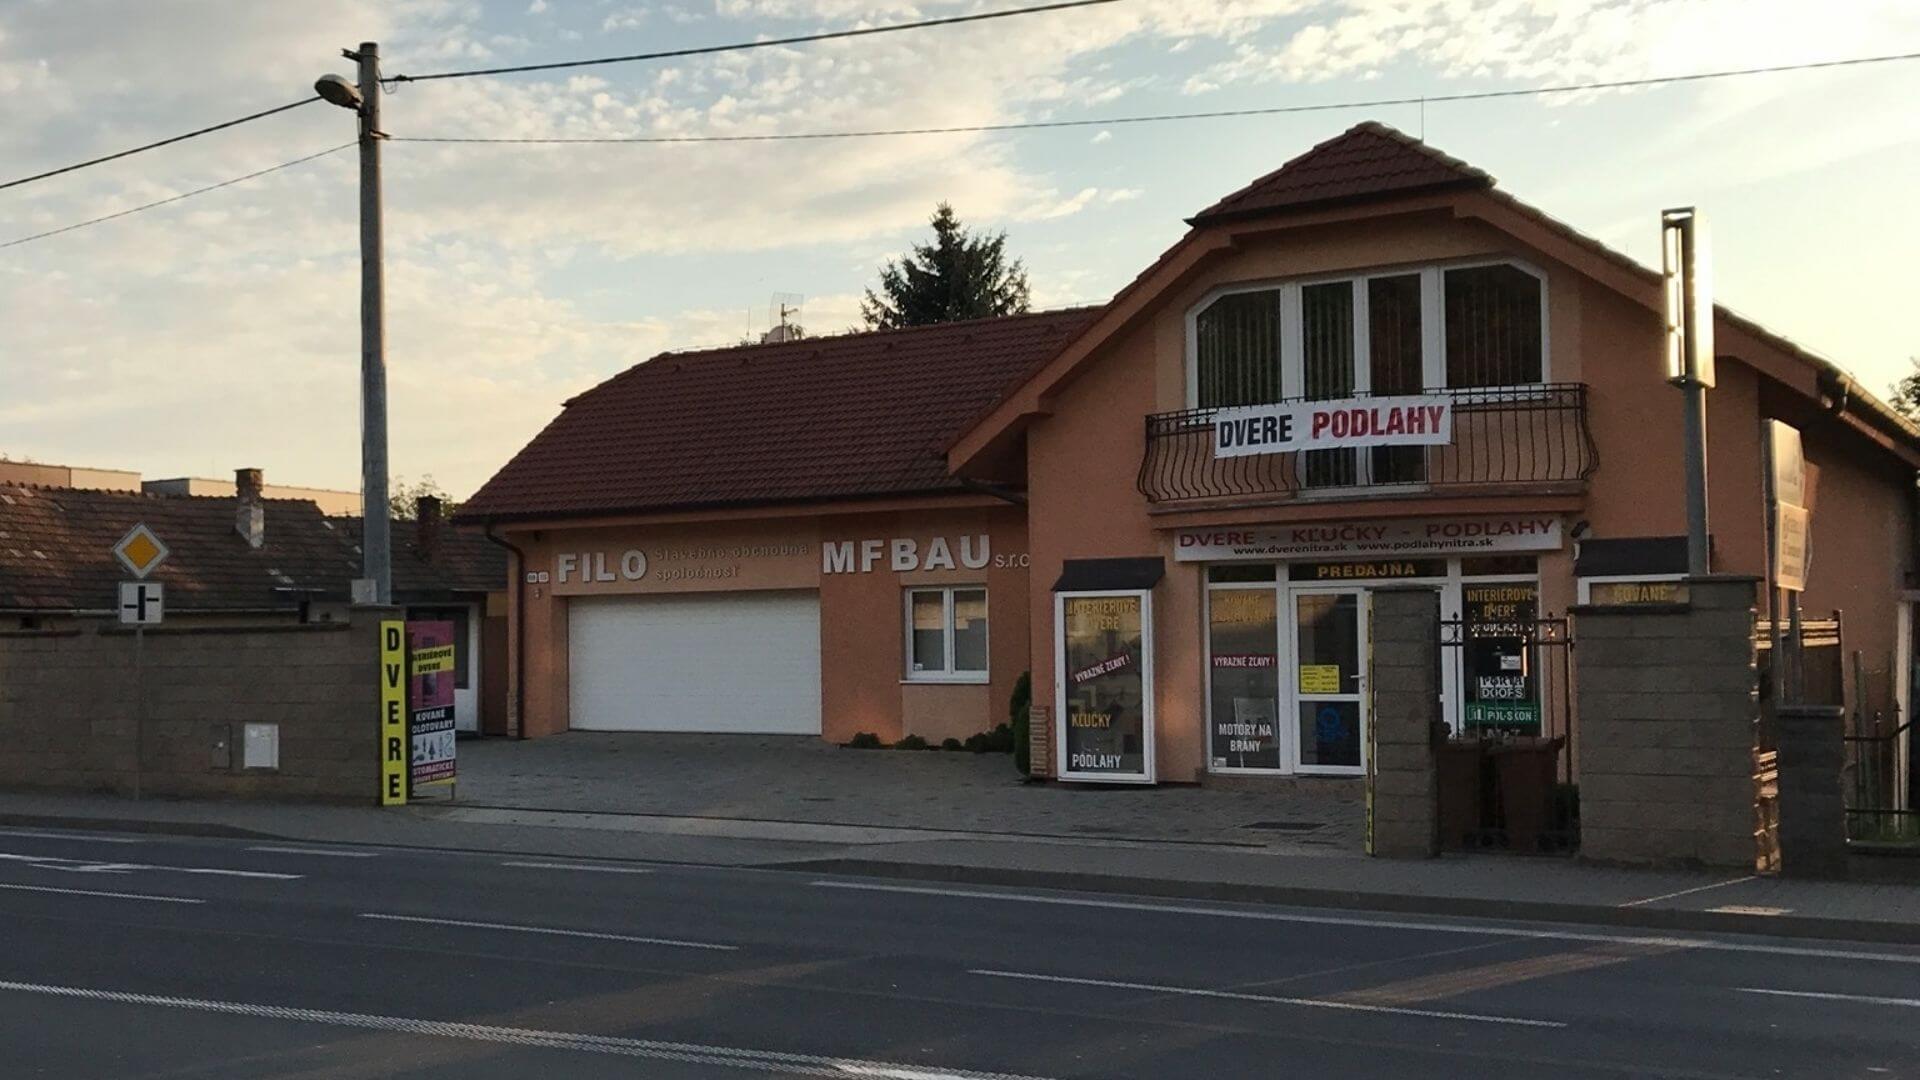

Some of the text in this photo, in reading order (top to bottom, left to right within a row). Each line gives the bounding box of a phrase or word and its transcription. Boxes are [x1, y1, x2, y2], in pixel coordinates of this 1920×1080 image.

[1219, 404, 1445, 448] DVERE PODLAHY
[1179, 530, 1255, 547] DVERE
[1426, 518, 1555, 539] PODLAHY
[1233, 538, 1494, 556] www.dverenitra.sk www.podlahynitra.sk
[558, 549, 648, 583] FILO
[823, 535, 990, 573] MFBAU
[386, 628, 401, 798] DVERE
[1219, 723, 1272, 736] MOTORY NA
[1072, 754, 1121, 769] PODLAHY
